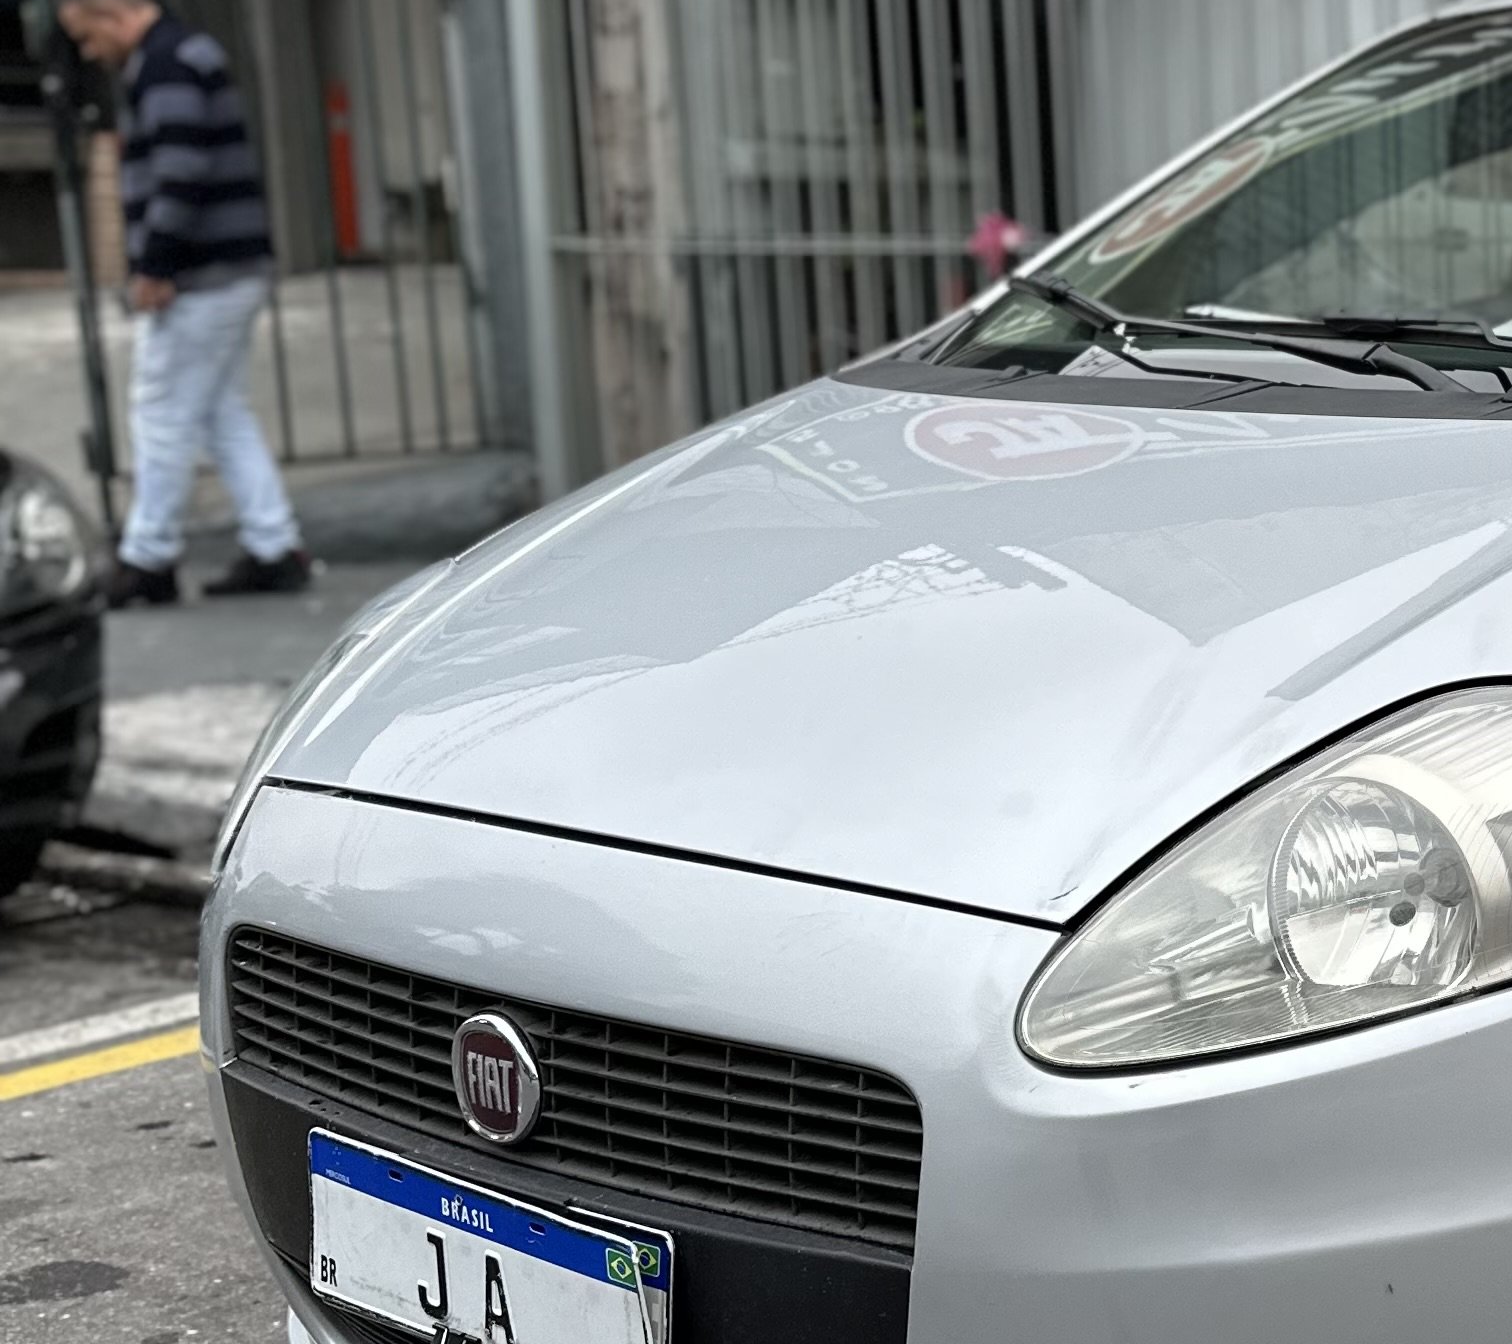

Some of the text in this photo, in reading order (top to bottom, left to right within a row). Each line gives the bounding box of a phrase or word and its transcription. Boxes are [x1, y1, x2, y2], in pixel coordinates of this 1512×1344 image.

[467, 1051, 514, 1114] FIAT
[441, 1196, 494, 1233] BRASIL
[320, 1253, 338, 1288] BR
